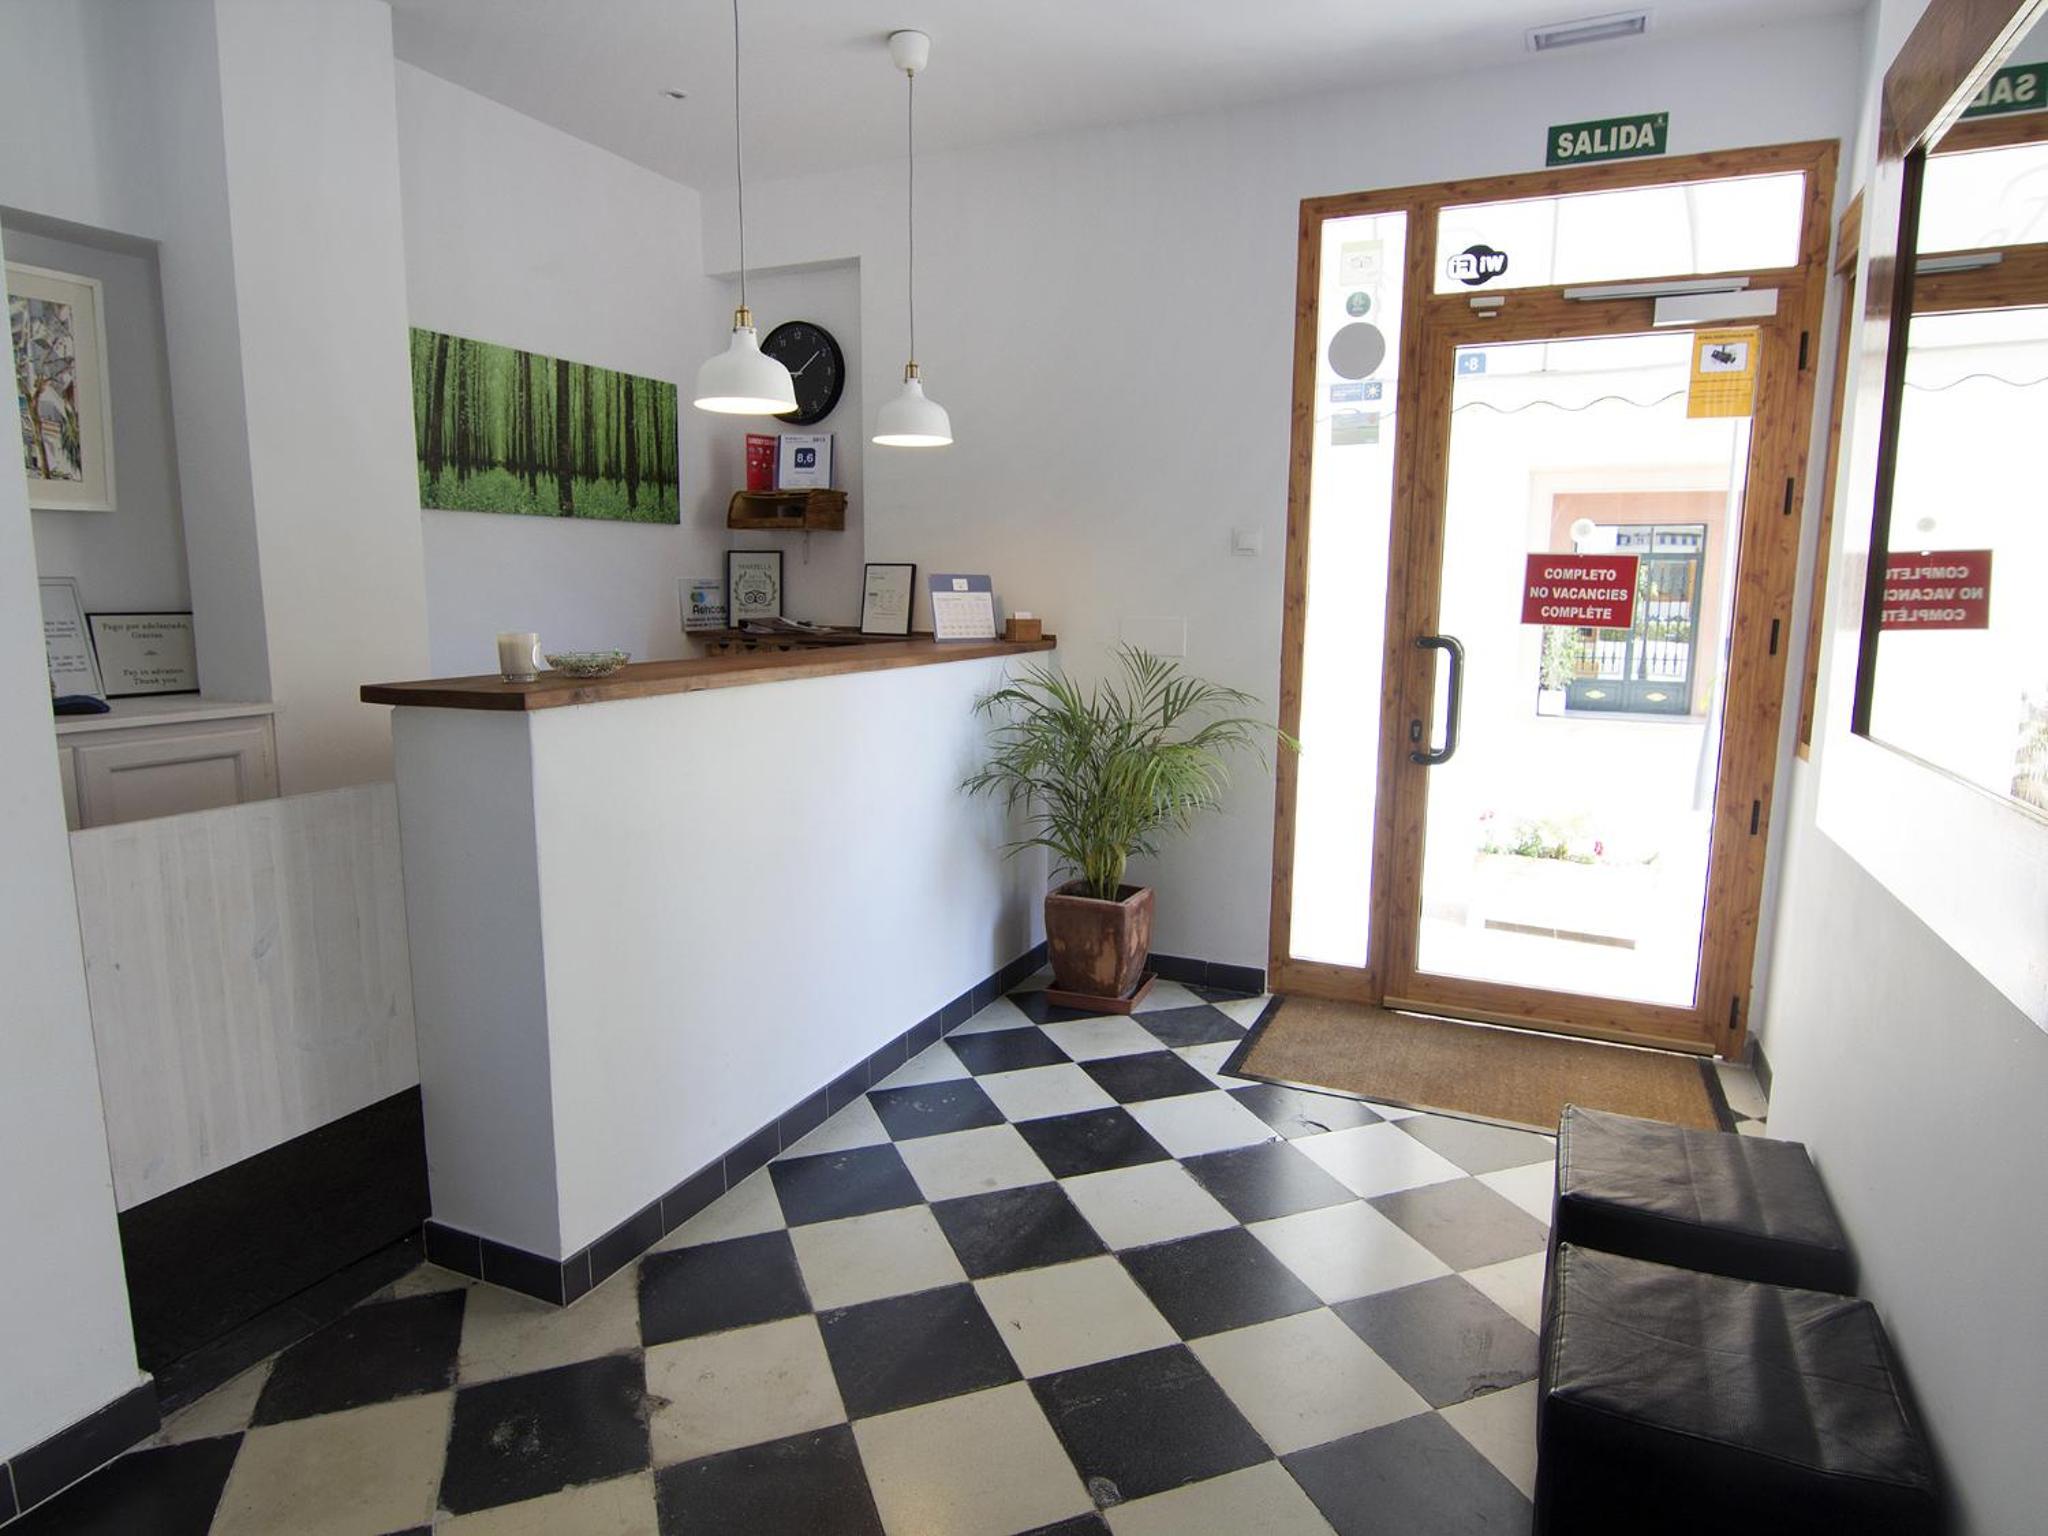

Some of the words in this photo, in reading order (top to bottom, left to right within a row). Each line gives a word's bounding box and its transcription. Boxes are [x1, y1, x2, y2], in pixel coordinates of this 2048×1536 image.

[1557, 122, 1656, 158] SALIDA
[1544, 567, 1617, 581] COMPLETO
[1529, 586, 1549, 598] NO
[1552, 587, 1628, 601] VACANCIES
